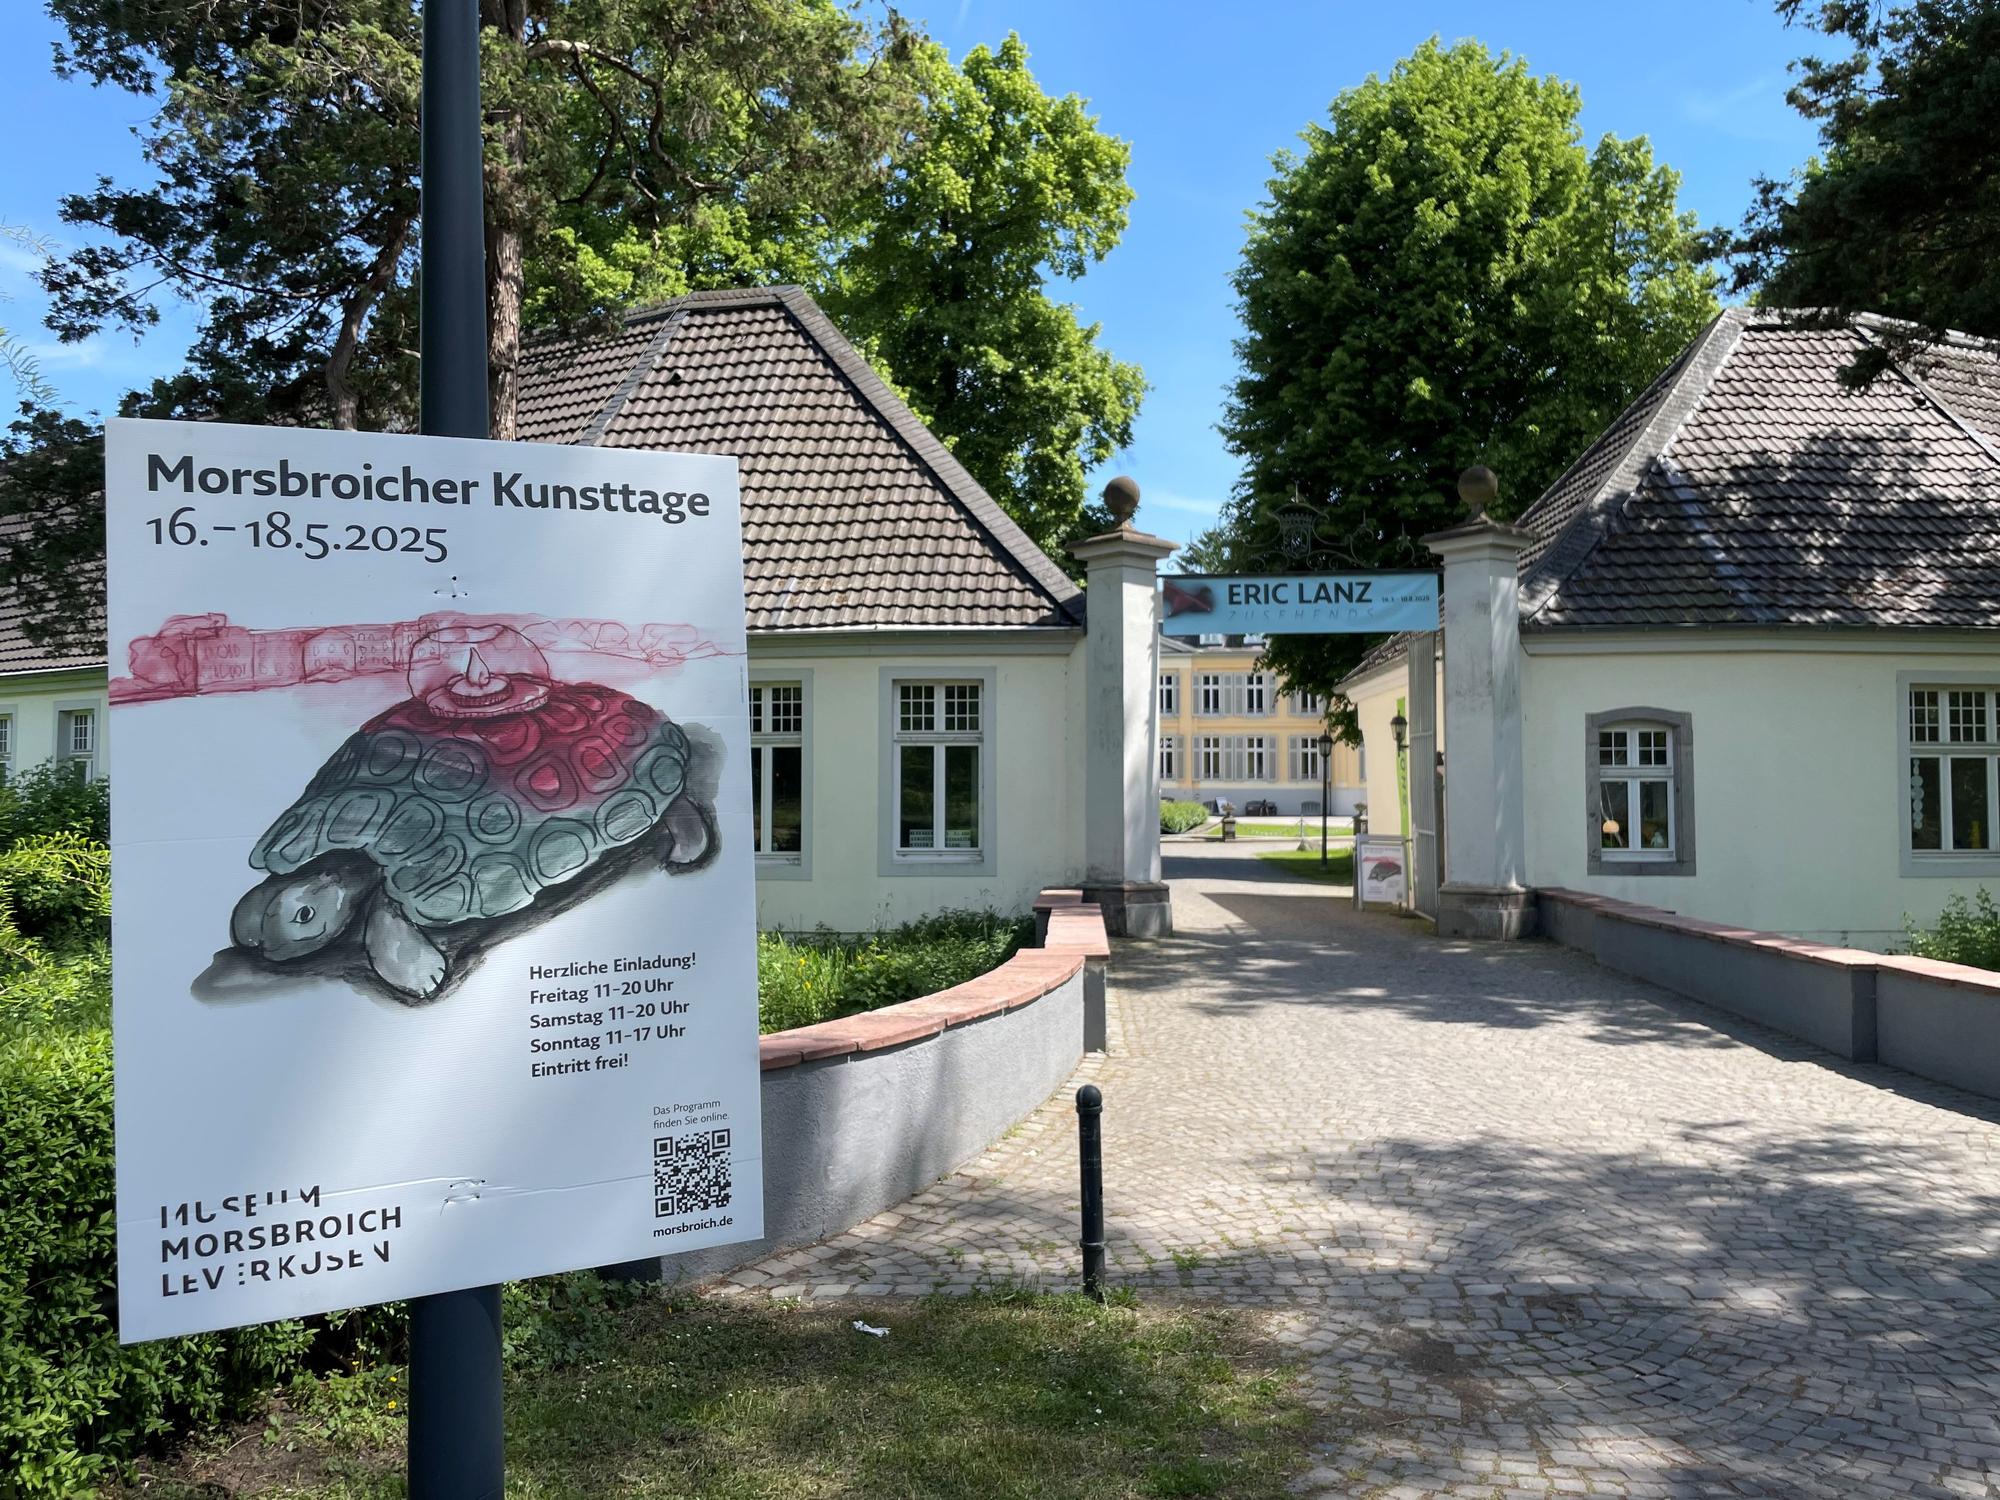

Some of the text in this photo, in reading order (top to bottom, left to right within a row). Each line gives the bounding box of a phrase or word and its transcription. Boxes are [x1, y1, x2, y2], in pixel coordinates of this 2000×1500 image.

[148, 454, 710, 524] Morsbroicher Kunsttage
[1228, 583, 1289, 606] ERIC
[1298, 581, 1373, 604] LANZ
[529, 952, 696, 980] Herzliche Einladung!
[530, 983, 589, 1005] Freitag
[645, 978, 674, 993] Uhr
[530, 1007, 604, 1029] Samstag
[660, 1000, 690, 1015] Uhr
[530, 1031, 601, 1054] Sonntag
[656, 1024, 686, 1039] Uhr
[531, 1053, 629, 1078] Eintritt frei!
[653, 1100, 721, 1116] Das Programm
[653, 1111, 730, 1129] finden Sie online.
[161, 1206, 402, 1263] MORSBROICH
[653, 1215, 733, 1237] morsbroich.de
